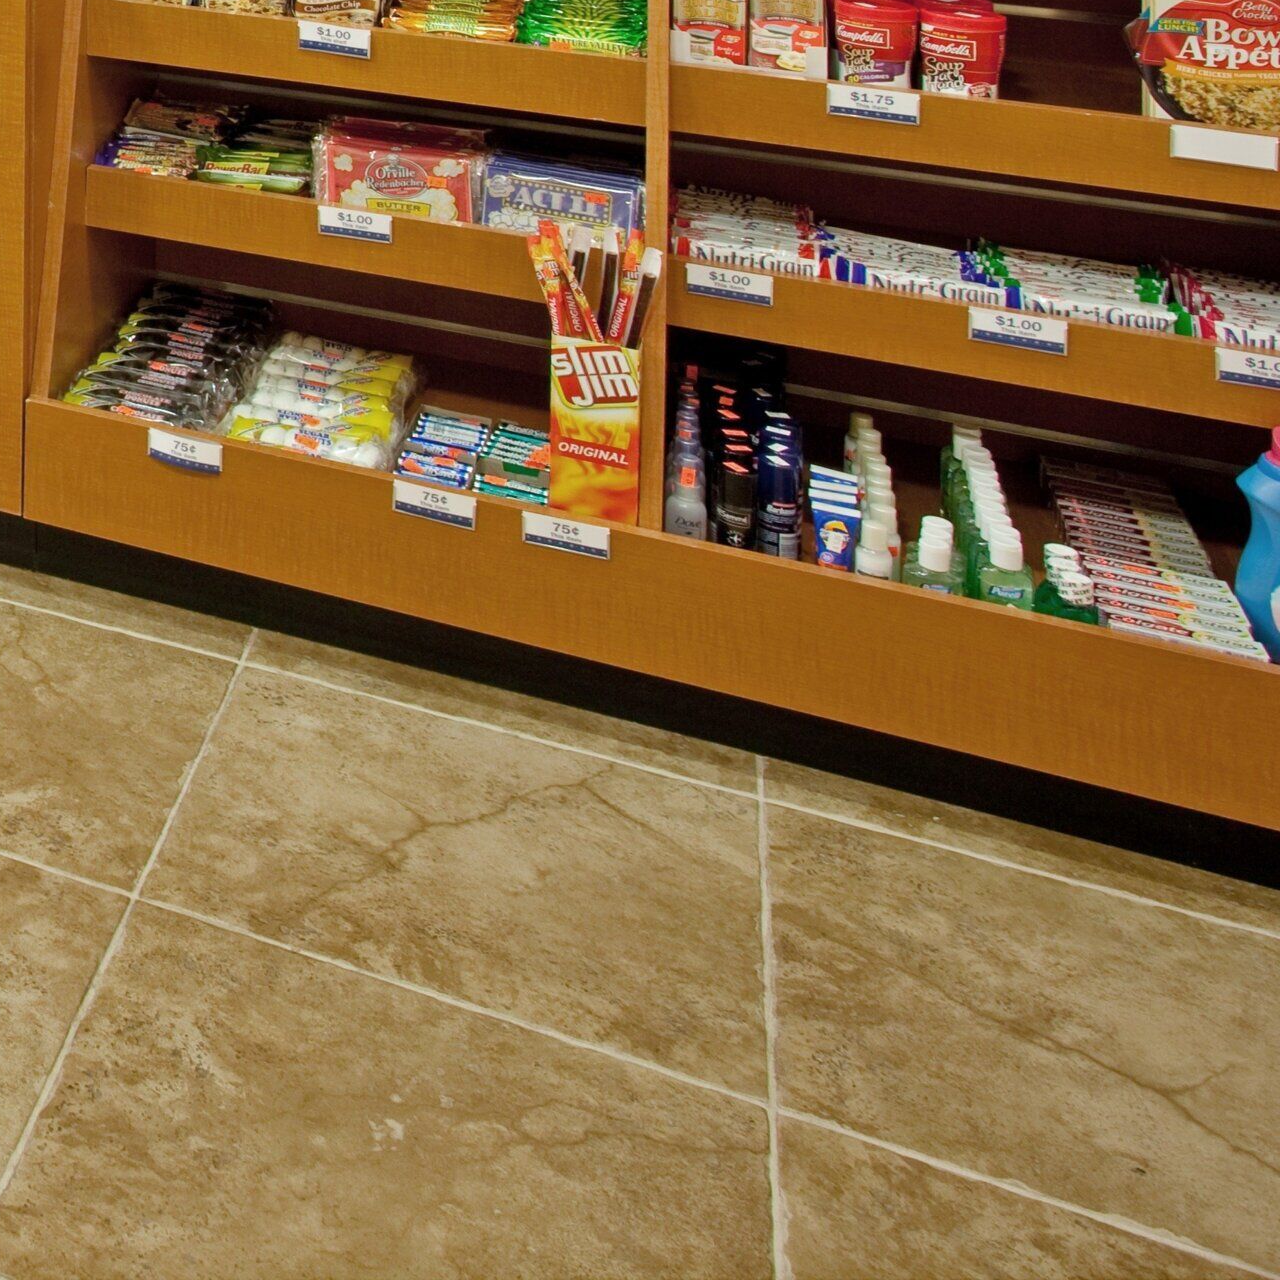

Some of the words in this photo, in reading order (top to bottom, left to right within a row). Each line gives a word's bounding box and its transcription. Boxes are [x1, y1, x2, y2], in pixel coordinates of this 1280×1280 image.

[304, 2, 339, 13] Chocolate
[341, 0, 362, 9] Chip
[1232, 8, 1279, 21] Crocker
[1241, 0, 1273, 15] Betty
[316, 26, 351, 40] $1.00
[836, 24, 886, 44] Campbell's
[1157, 24, 1200, 33] LUNCH!
[1202, 17, 1280, 45] Bow
[843, 44, 875, 61] Soup
[920, 38, 972, 58] Campbell's
[924, 56, 964, 75] Soup
[850, 92, 895, 106] $1.75
[205, 162, 264, 175] PowerBar
[375, 167, 416, 180] Orville
[514, 185, 564, 210] ACT
[376, 201, 422, 212] BUTTER
[337, 212, 373, 225] $1.00
[696, 246, 814, 277] Nutri-Grain
[708, 270, 751, 286] $1.00
[872, 274, 999, 305] Nutri-Grain
[567, 291, 582, 333] ORIGINAL
[609, 297, 629, 338] ORIGINAL
[995, 315, 1042, 332] $1.00
[173, 440, 197, 453] 75¢
[558, 441, 629, 466] ORIGINAL
[422, 491, 448, 505] 75¢
[552, 522, 580, 536] 75¢
[1110, 613, 1190, 636] Colgate
